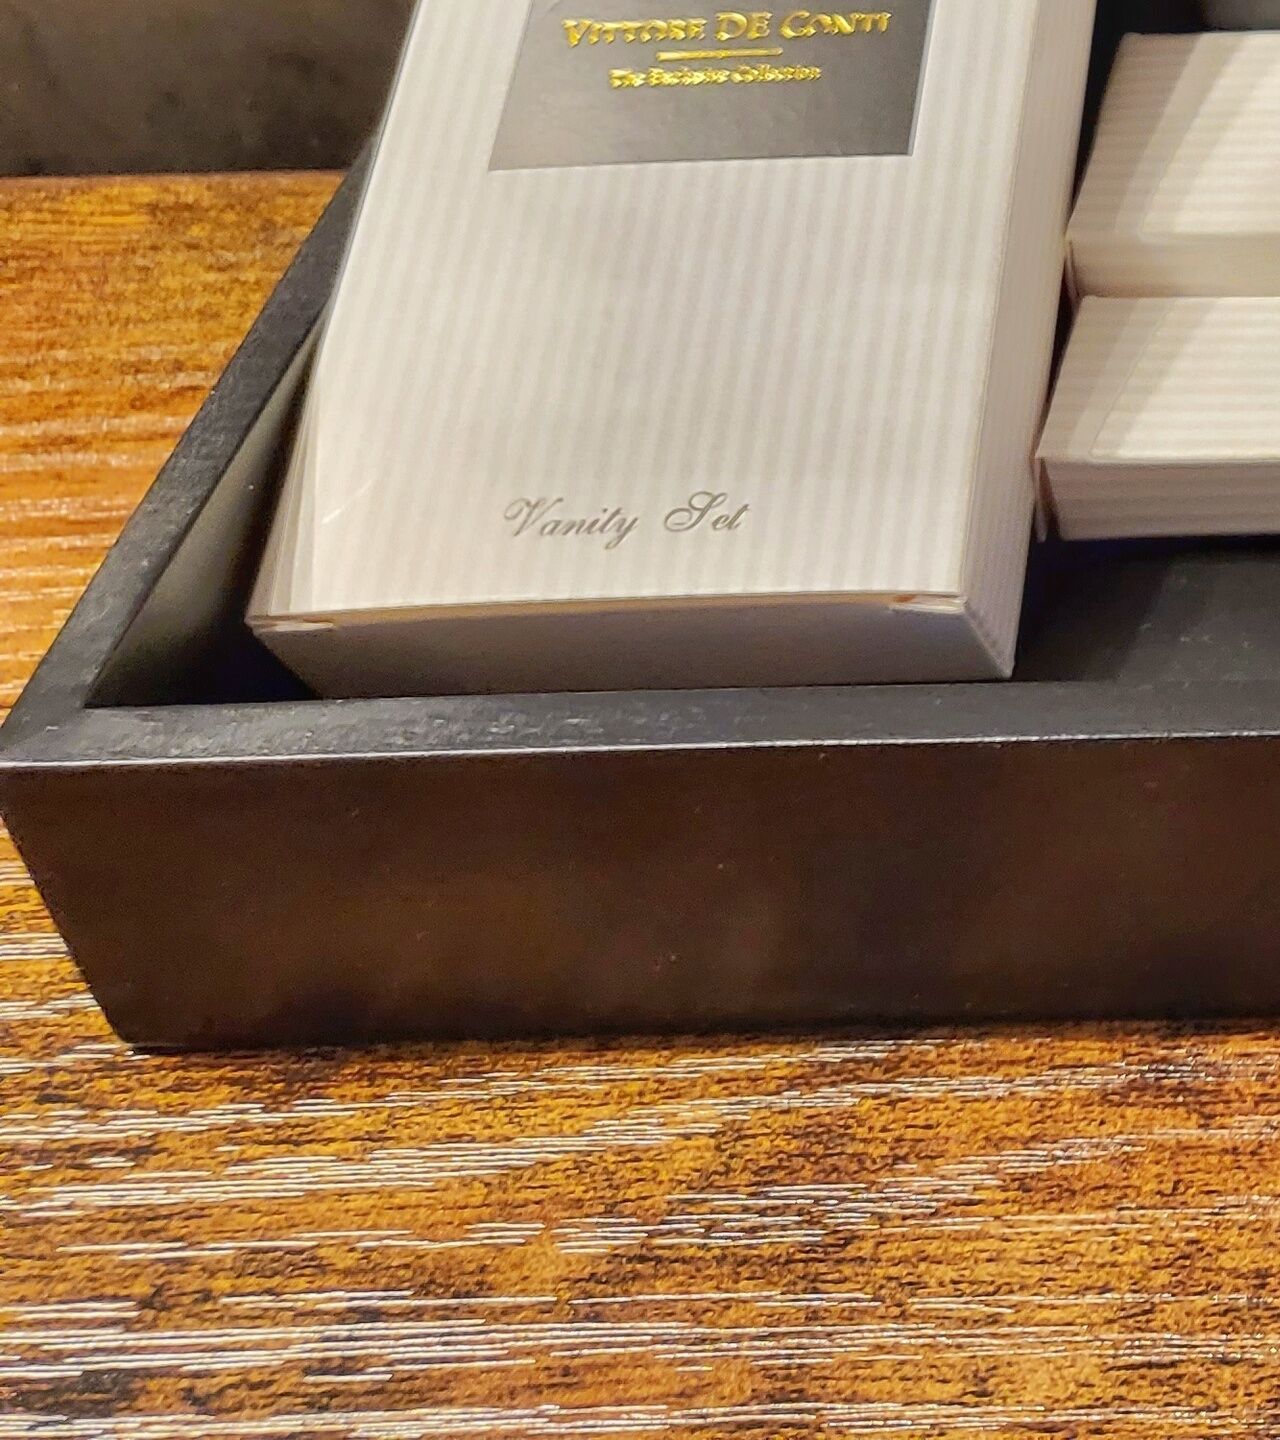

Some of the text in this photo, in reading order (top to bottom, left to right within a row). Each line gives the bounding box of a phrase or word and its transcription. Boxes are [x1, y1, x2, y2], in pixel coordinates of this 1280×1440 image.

[560, 9, 892, 48] VITTORE DE CONTI
[503, 490, 750, 551] Vanity Set
